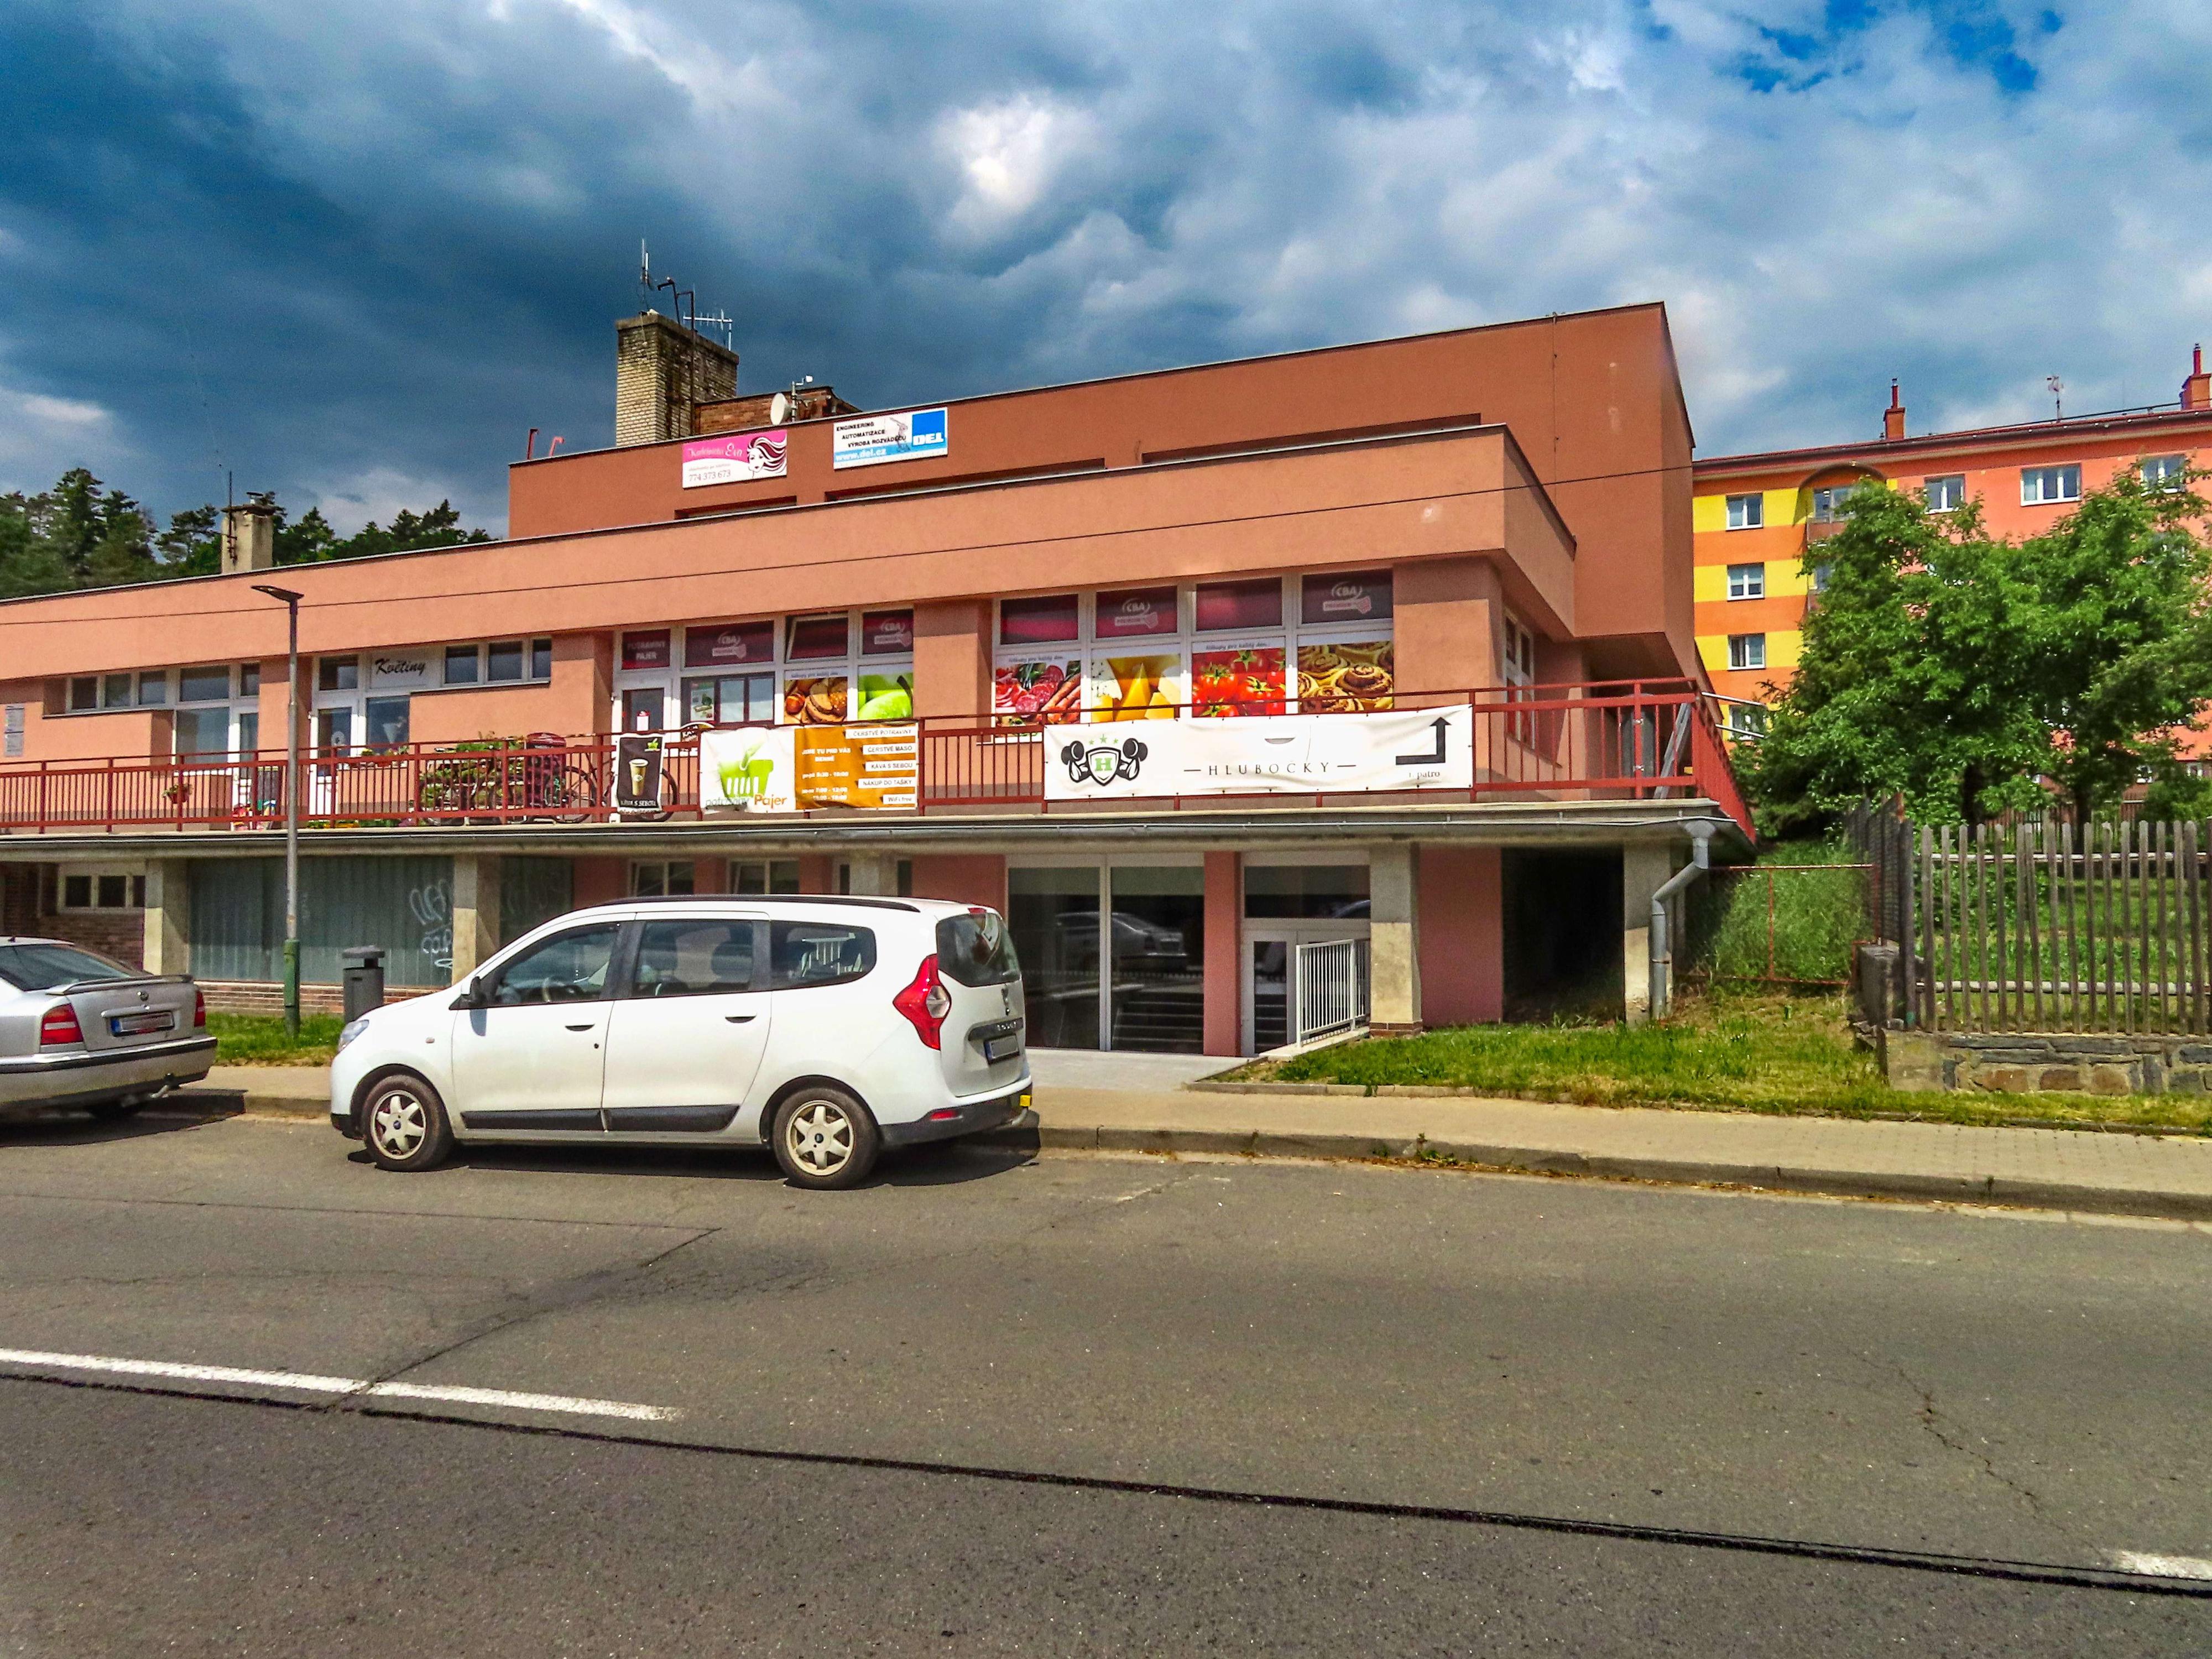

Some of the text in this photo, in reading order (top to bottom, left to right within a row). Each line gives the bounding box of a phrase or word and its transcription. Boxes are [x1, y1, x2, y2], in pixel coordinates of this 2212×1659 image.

[837, 421, 874, 431] ENGINEERING
[842, 429, 885, 440] AUTOMATIZACE
[913, 432, 944, 446] DEL
[836, 448, 886, 461] www.del.cz
[703, 472, 716, 480] 373
[1095, 757, 1113, 771] H
[1208, 760, 1329, 775] HLUBOČKY
[1417, 771, 1440, 780] patro
[754, 794, 787, 808] Pajer
